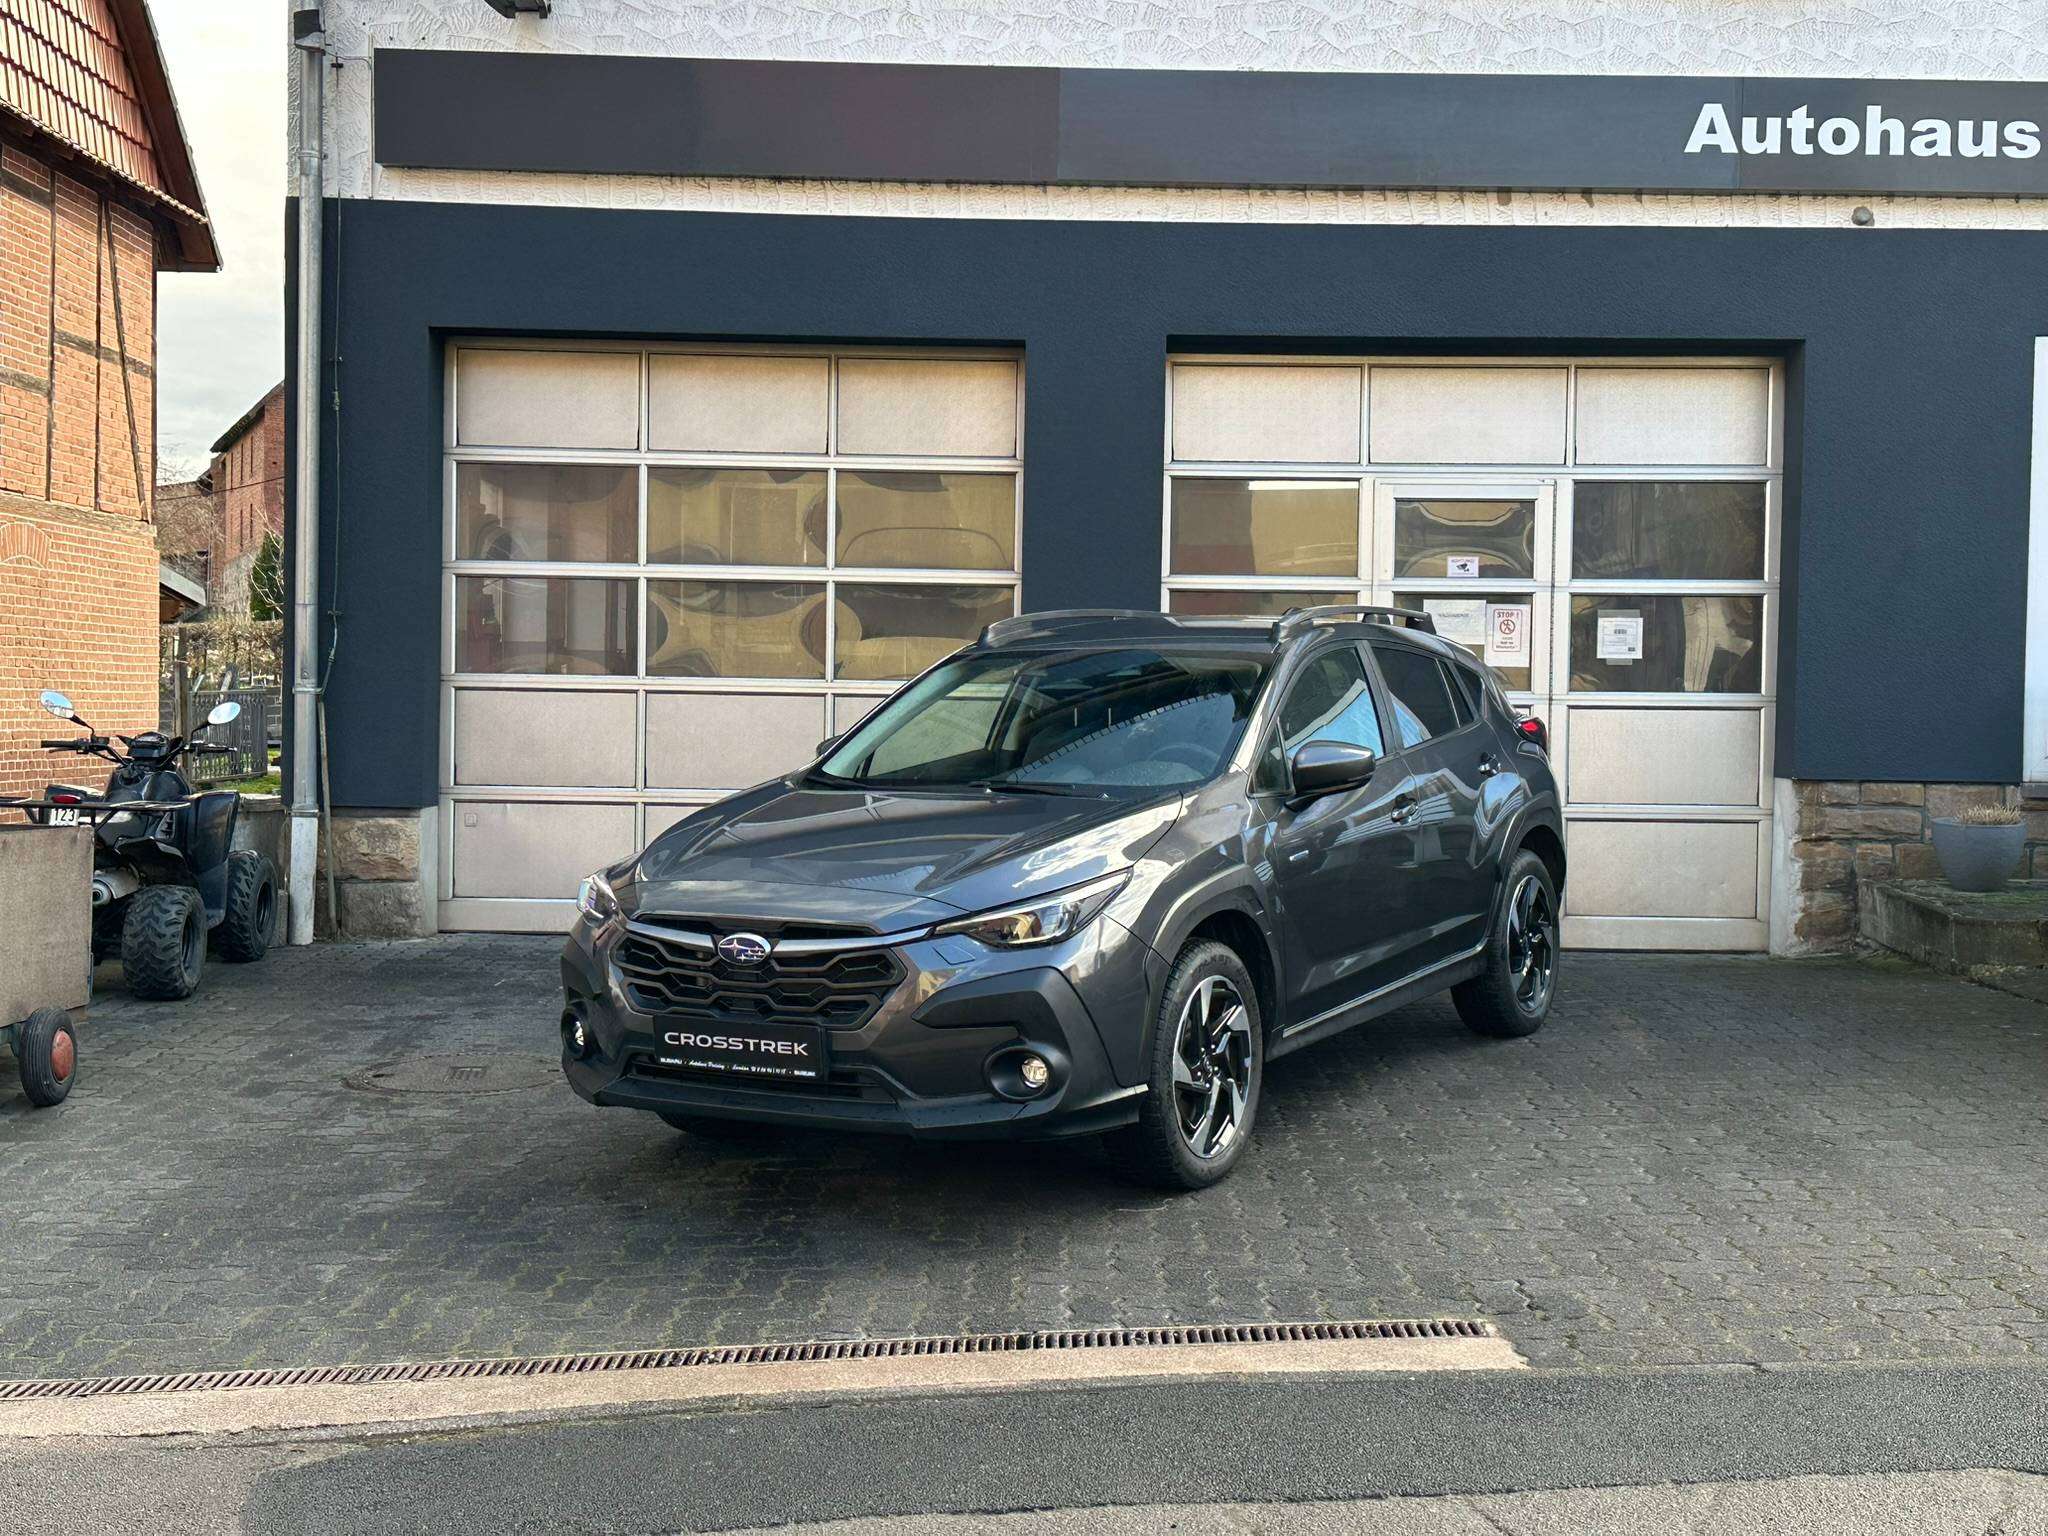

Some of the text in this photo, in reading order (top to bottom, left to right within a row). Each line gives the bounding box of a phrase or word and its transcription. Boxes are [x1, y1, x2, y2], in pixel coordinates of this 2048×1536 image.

[1684, 102, 2041, 159] Autohaus
[55, 807, 75, 821] 123
[664, 1032, 809, 1056] CROSSTREK
